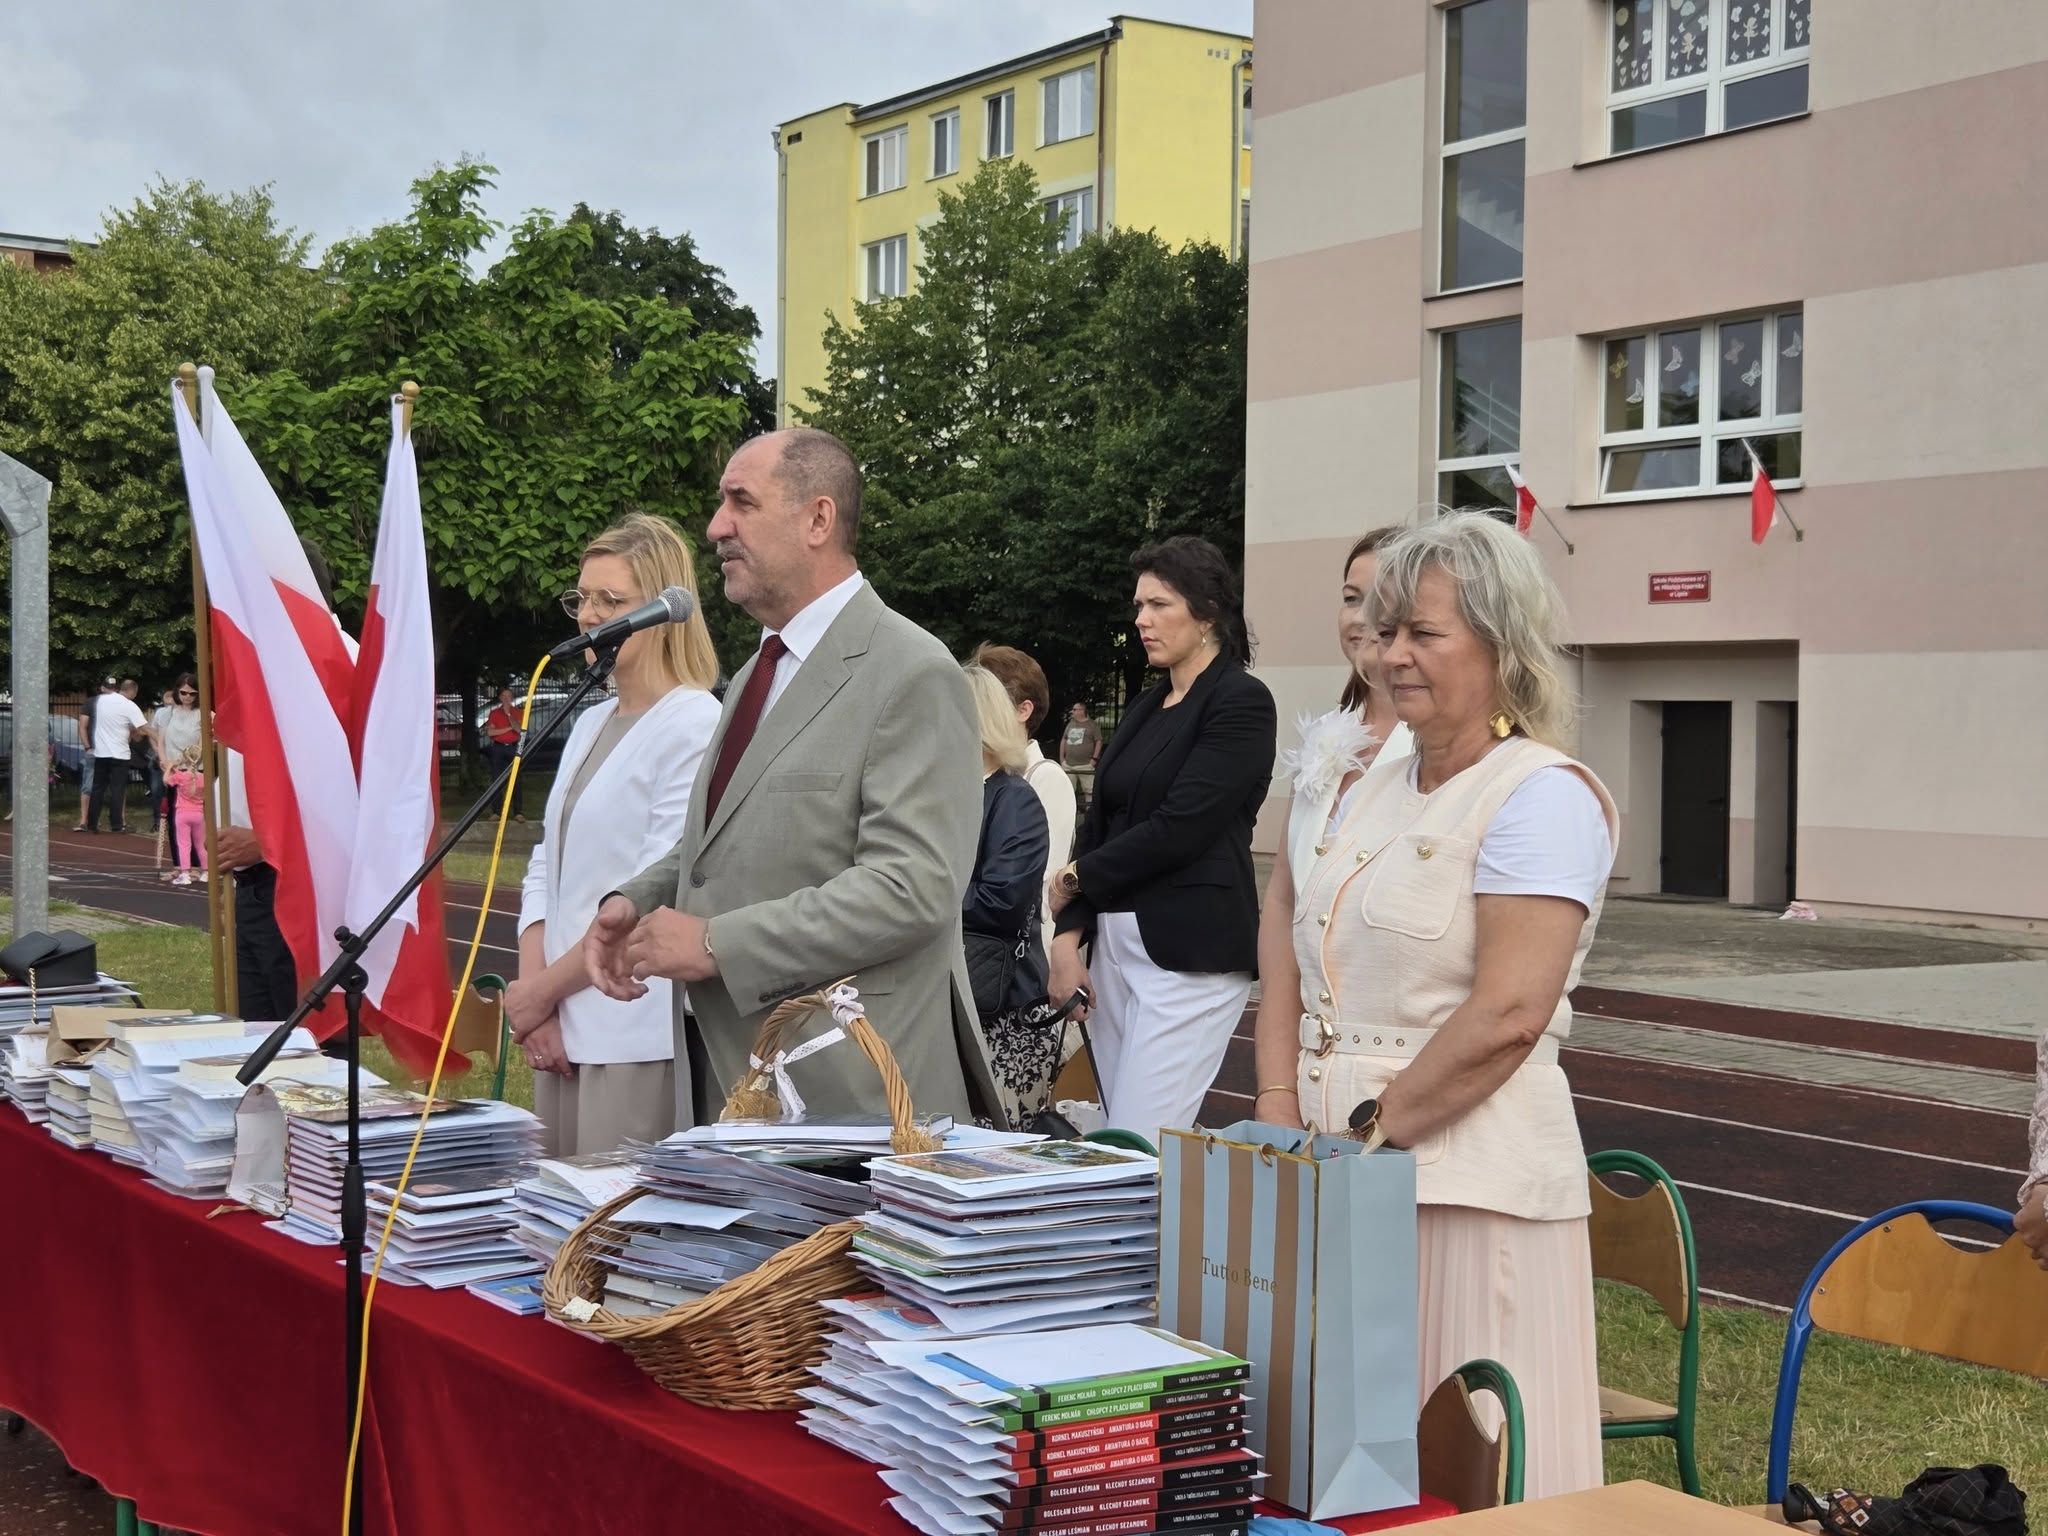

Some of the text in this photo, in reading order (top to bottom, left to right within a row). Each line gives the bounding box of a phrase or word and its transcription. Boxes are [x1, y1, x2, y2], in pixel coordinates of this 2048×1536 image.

[1201, 1256, 1278, 1294] Tutto Bene
[1058, 1394, 1076, 1403] FERENC
[1077, 1390, 1096, 1400] MOLNÁR
[1102, 1387, 1123, 1396] CHŁOPCY
[1127, 1384, 1143, 1392] PLACU
[1143, 1381, 1158, 1390] BRONI
[1041, 1412, 1060, 1422] FERENC
[1061, 1409, 1081, 1420] MOLNÁR
[1086, 1406, 1108, 1416] CHŁOPCY
[1113, 1403, 1129, 1412] PLACU
[1129, 1401, 1144, 1410] BRONI
[1052, 1433, 1070, 1442] KORNEL
[1071, 1427, 1104, 1439] MAKUSZYŃSKI
[1109, 1422, 1135, 1433] AWANTURA
[1139, 1419, 1154, 1428] BASIĘ
[1046, 1450, 1065, 1460] KORNEL
[1066, 1444, 1100, 1457] MAKUSZYŃSKI
[1104, 1440, 1131, 1451] AWANTURA
[1135, 1437, 1149, 1446] BASIĘ
[1053, 1454, 1154, 1478] KORNEL MAKUSZYŃSKI AWANTURA O BASIĘ
[1050, 1476, 1156, 1498] BOLESŁAW LEŚMIAN KLECHDY SEZAMOWE
[1043, 1498, 1150, 1518] BOLESŁAW LEŚMIAN KLECHDY SEZAMOWE
[1068, 1526, 1090, 1536] LEŚMIAN
[1095, 1522, 1118, 1532] KLECHDY
[1119, 1520, 1148, 1529] SEZAMOWE
